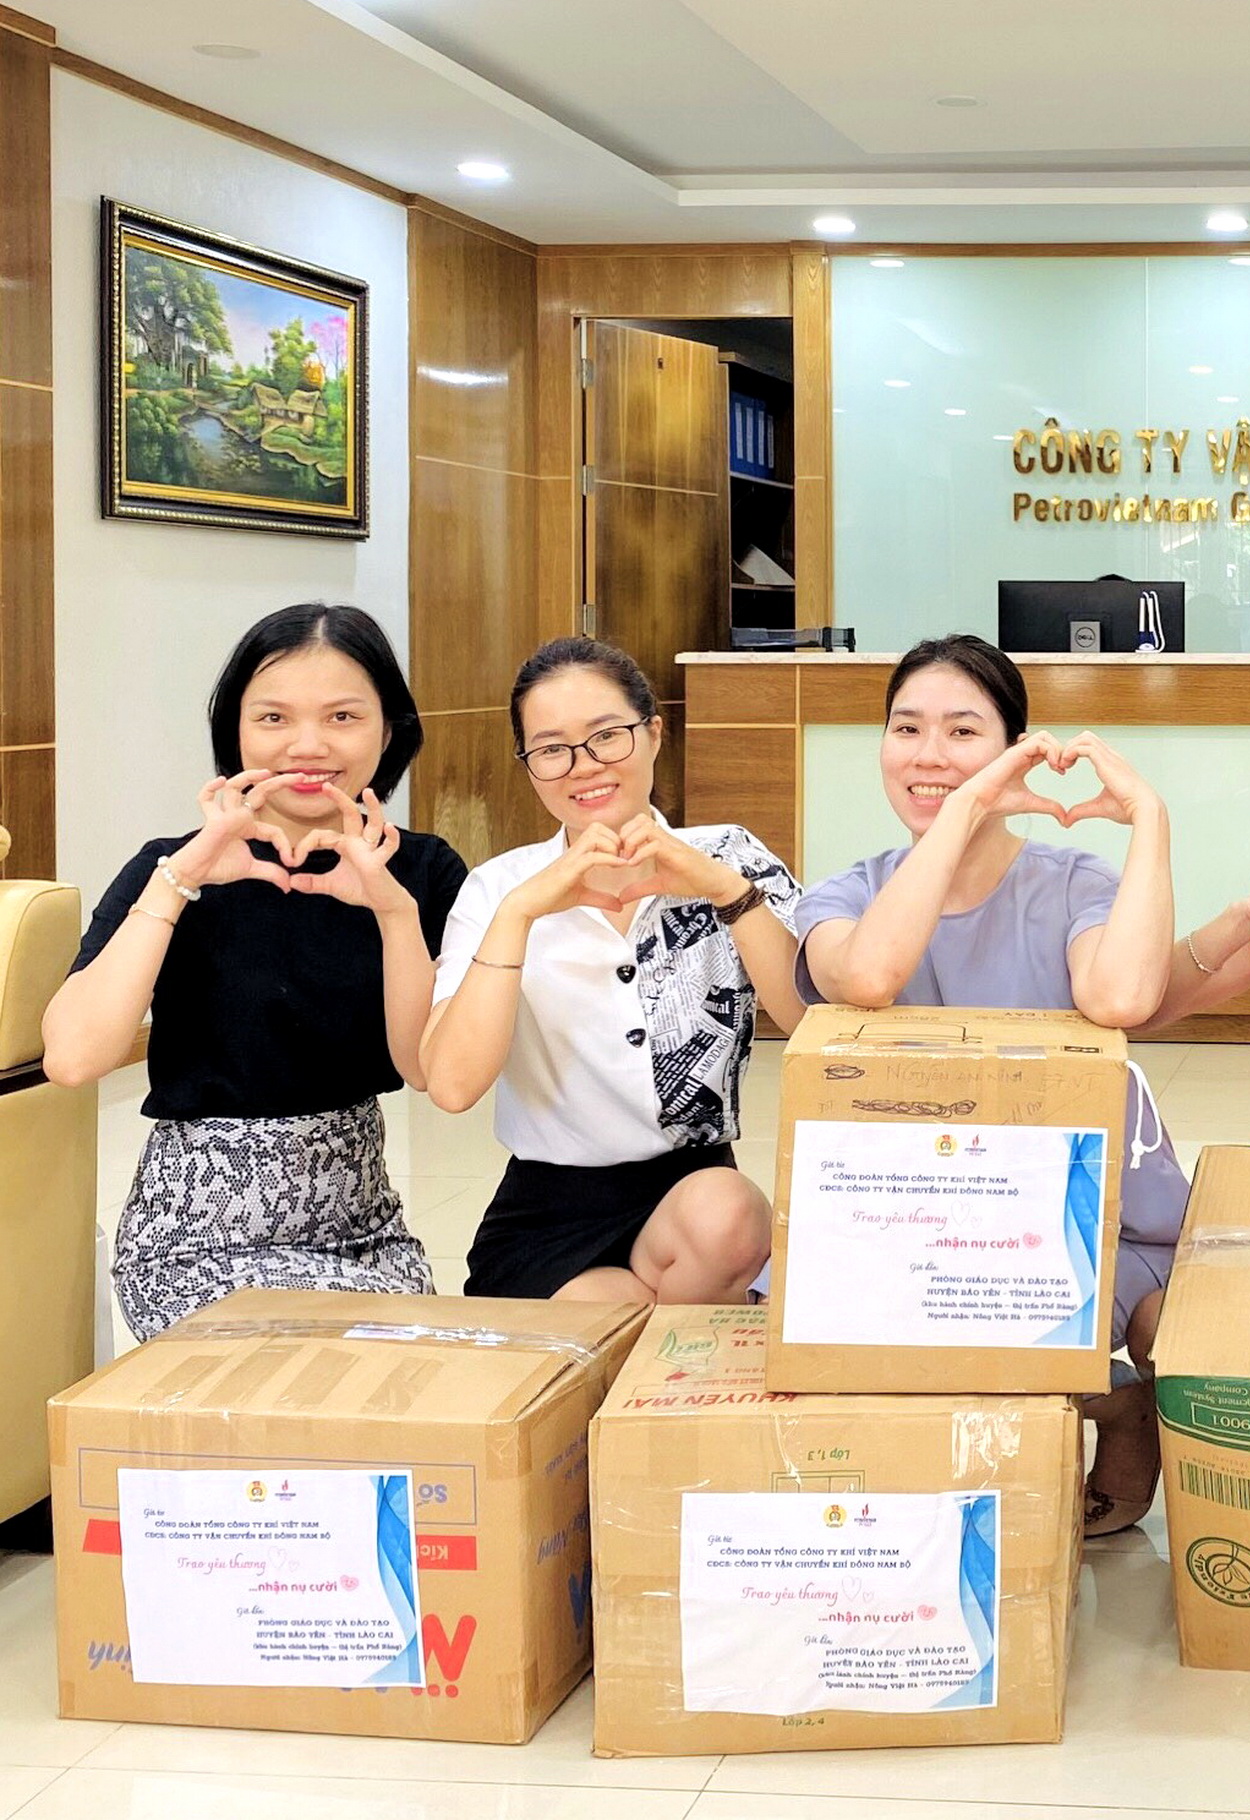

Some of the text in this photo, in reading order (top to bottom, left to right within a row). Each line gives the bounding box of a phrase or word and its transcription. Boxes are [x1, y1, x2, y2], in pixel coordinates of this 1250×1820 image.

[1013, 417, 1121, 474] CÔNG
[1135, 429, 1190, 473] TY
[1013, 492, 1218, 523] Petrovietnam
[971, 1240, 987, 1251] nụ
[990, 1237, 1020, 1249] cười
[1212, 1414, 1250, 1430] 9001
[416, 1484, 448, 1506] Số
[416, 1544, 449, 1561] Kíc
[291, 1583, 306, 1594] nụ
[309, 1581, 337, 1592] cười
[864, 1613, 880, 1624] nụ
[884, 1611, 914, 1623] cười
